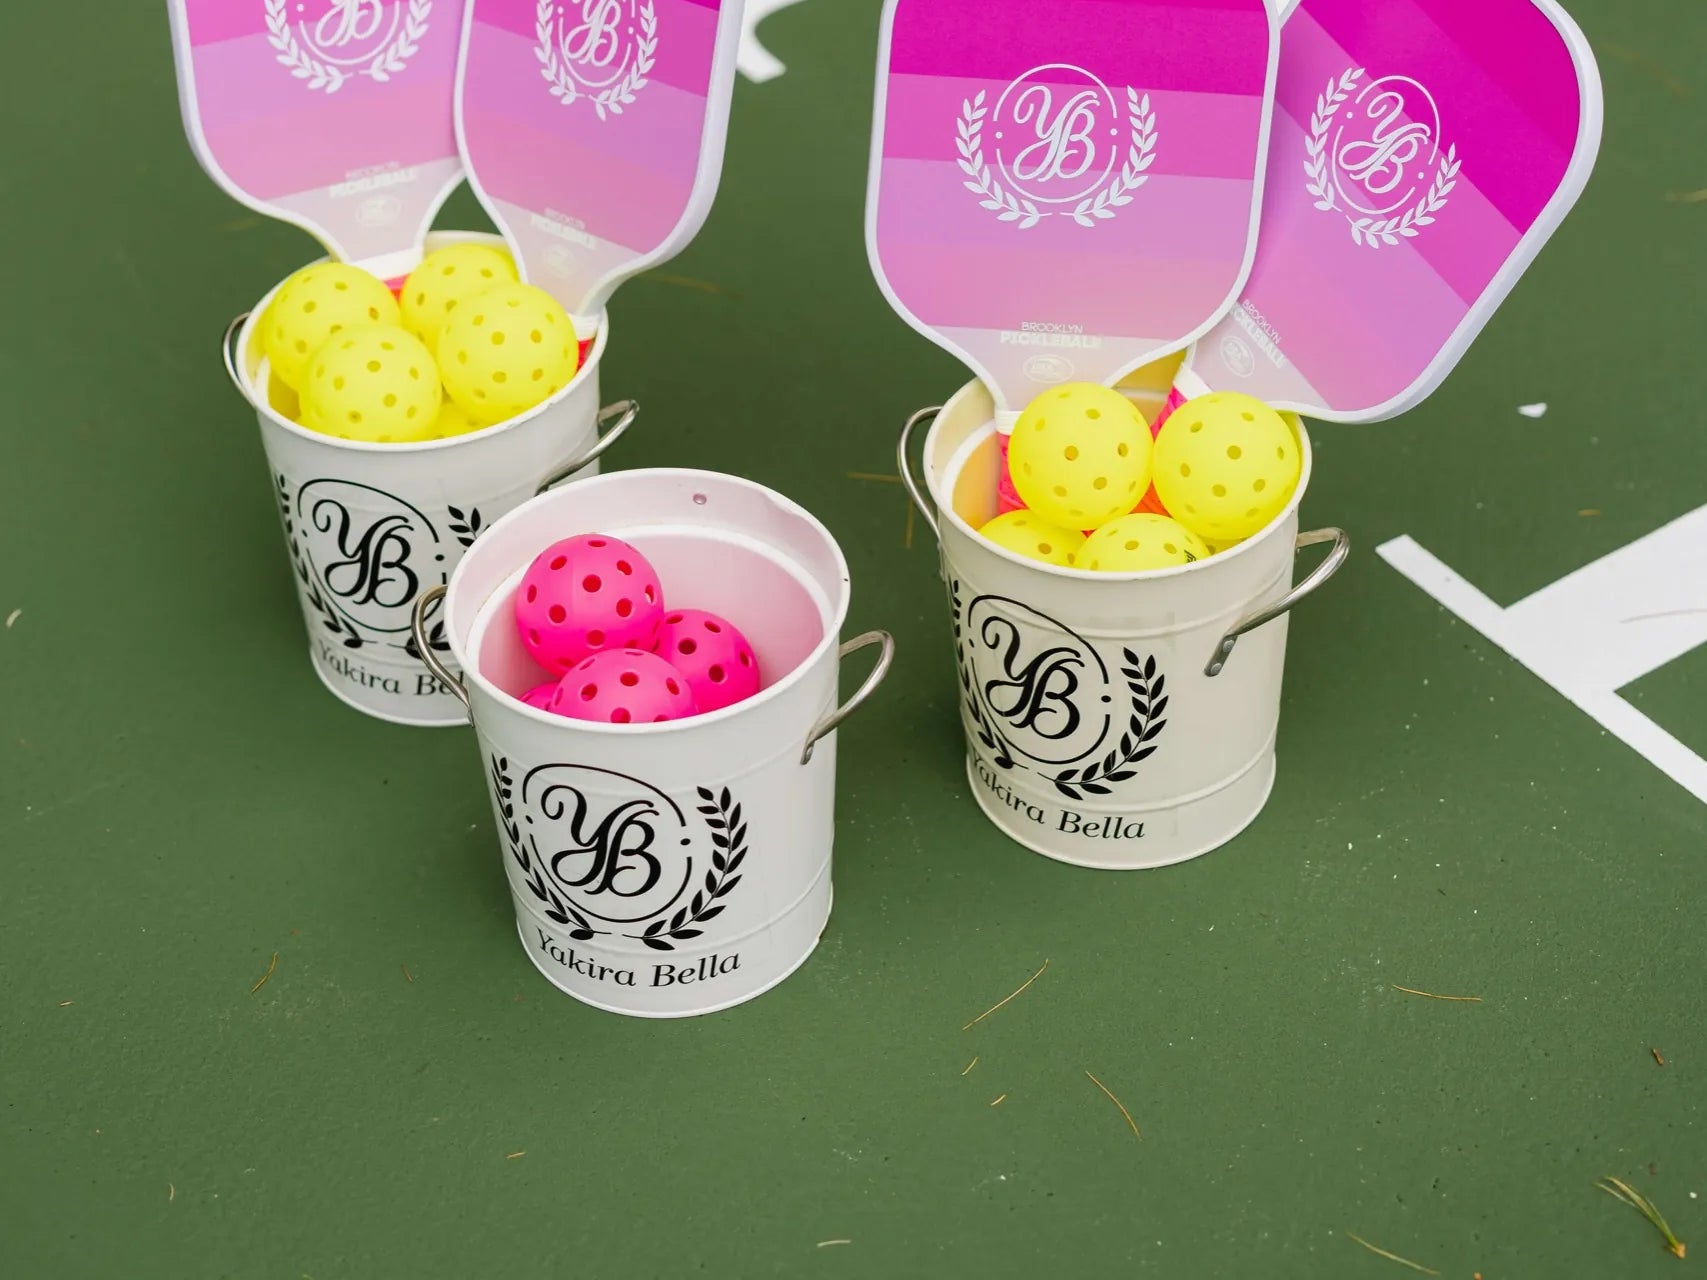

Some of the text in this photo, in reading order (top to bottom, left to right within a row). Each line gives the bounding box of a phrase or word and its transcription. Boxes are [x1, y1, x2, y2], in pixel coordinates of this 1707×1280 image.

[1021, 321, 1083, 334] BROOKLYN
[1242, 299, 1282, 345] BROOKLYN
[319, 639, 401, 694] Yakira
[971, 746, 1145, 839] Yakira Bella
[536, 925, 742, 988] Yakira Bella
